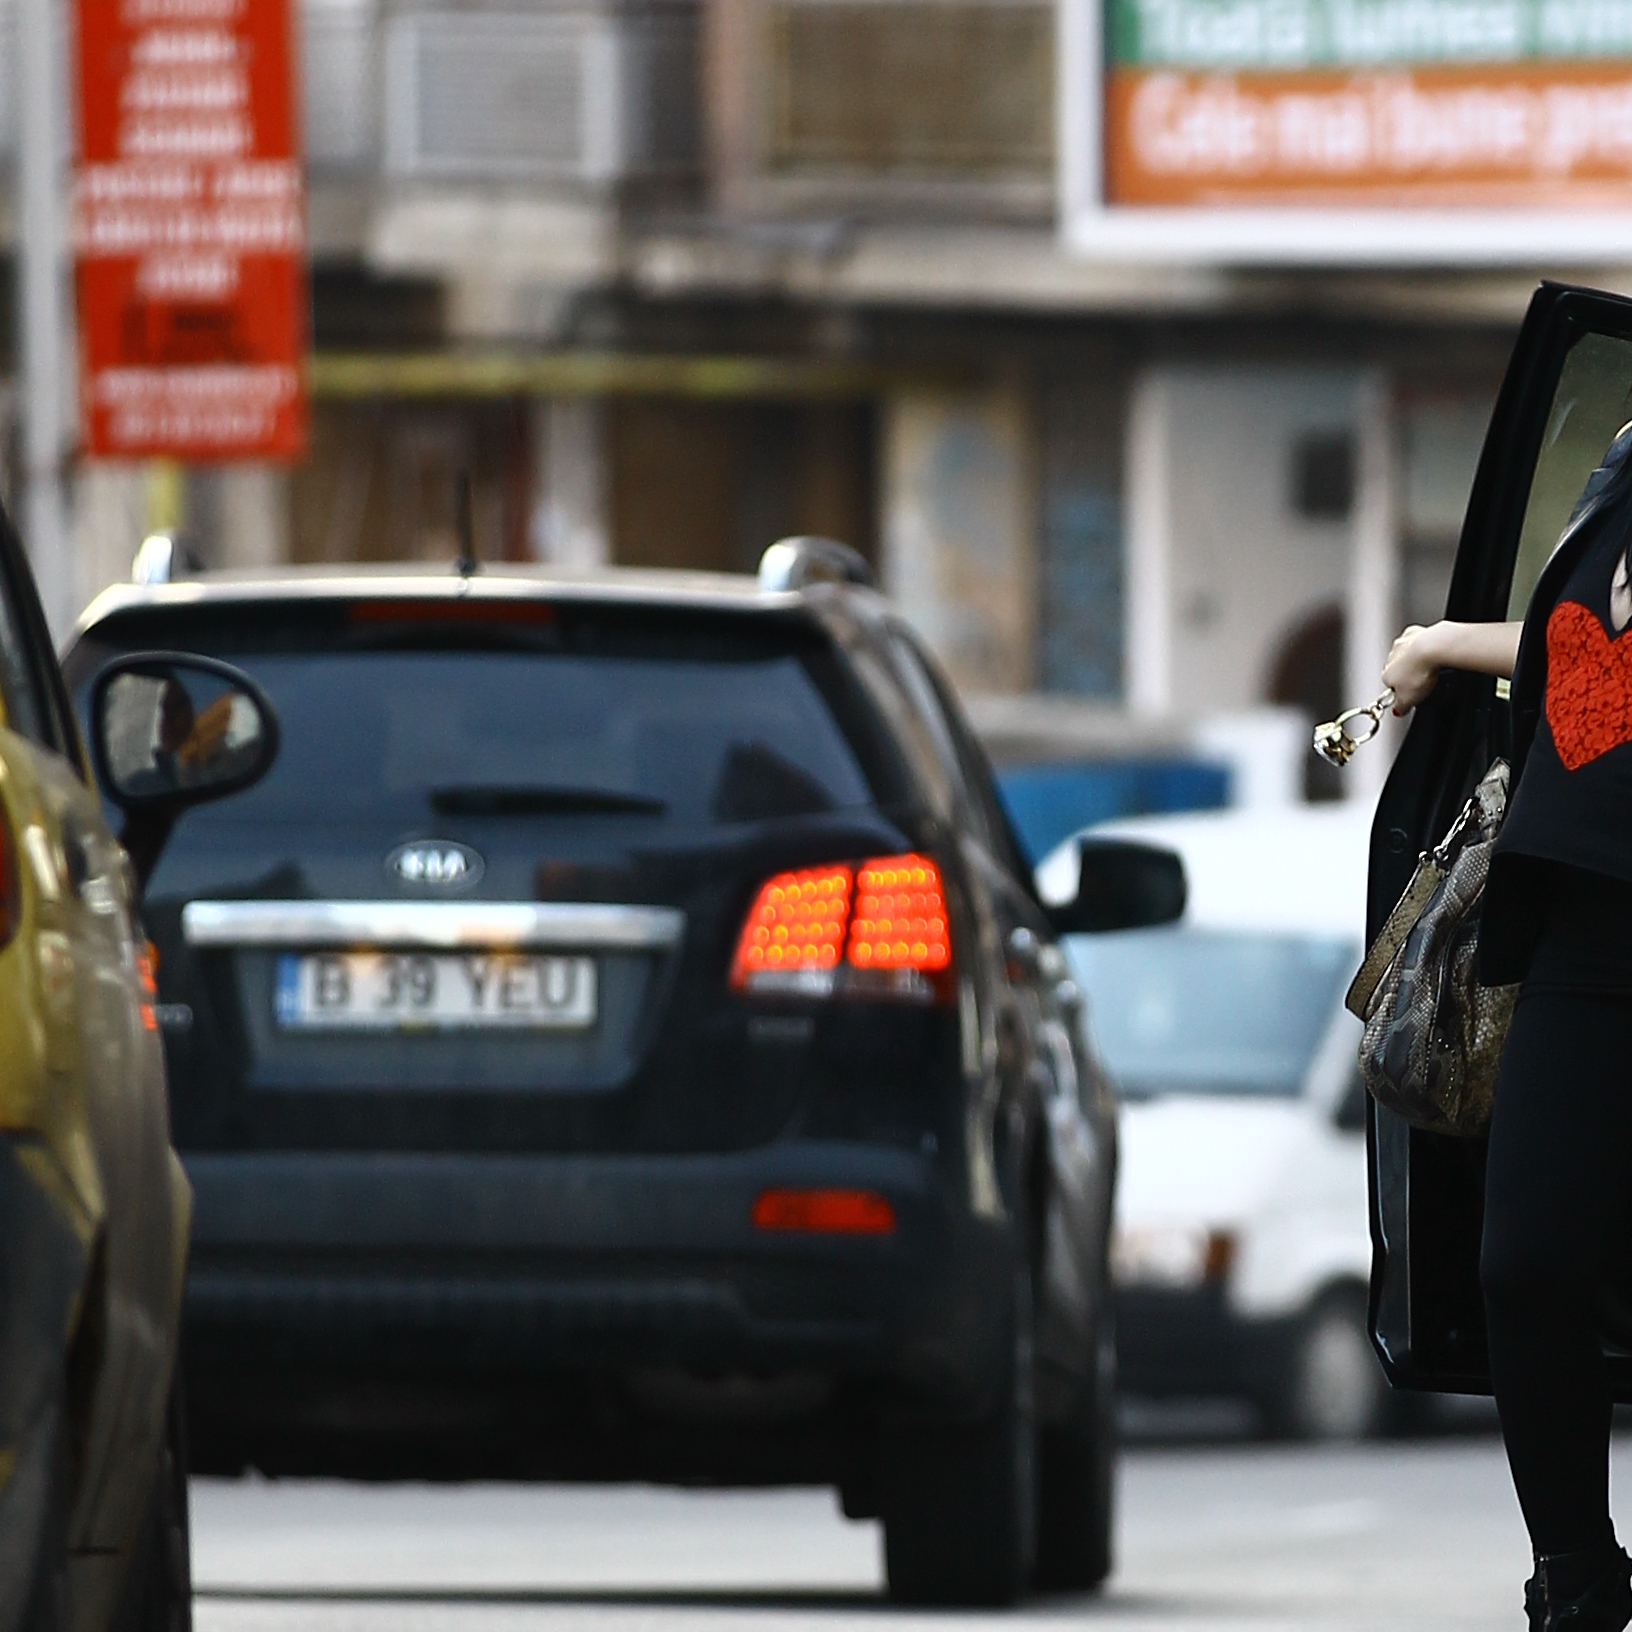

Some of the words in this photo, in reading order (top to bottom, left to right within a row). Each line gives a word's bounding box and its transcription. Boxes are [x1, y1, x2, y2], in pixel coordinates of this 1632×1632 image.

[398, 850, 466, 882] KIA
[315, 952, 353, 1009] B
[461, 953, 577, 1009] YEU
